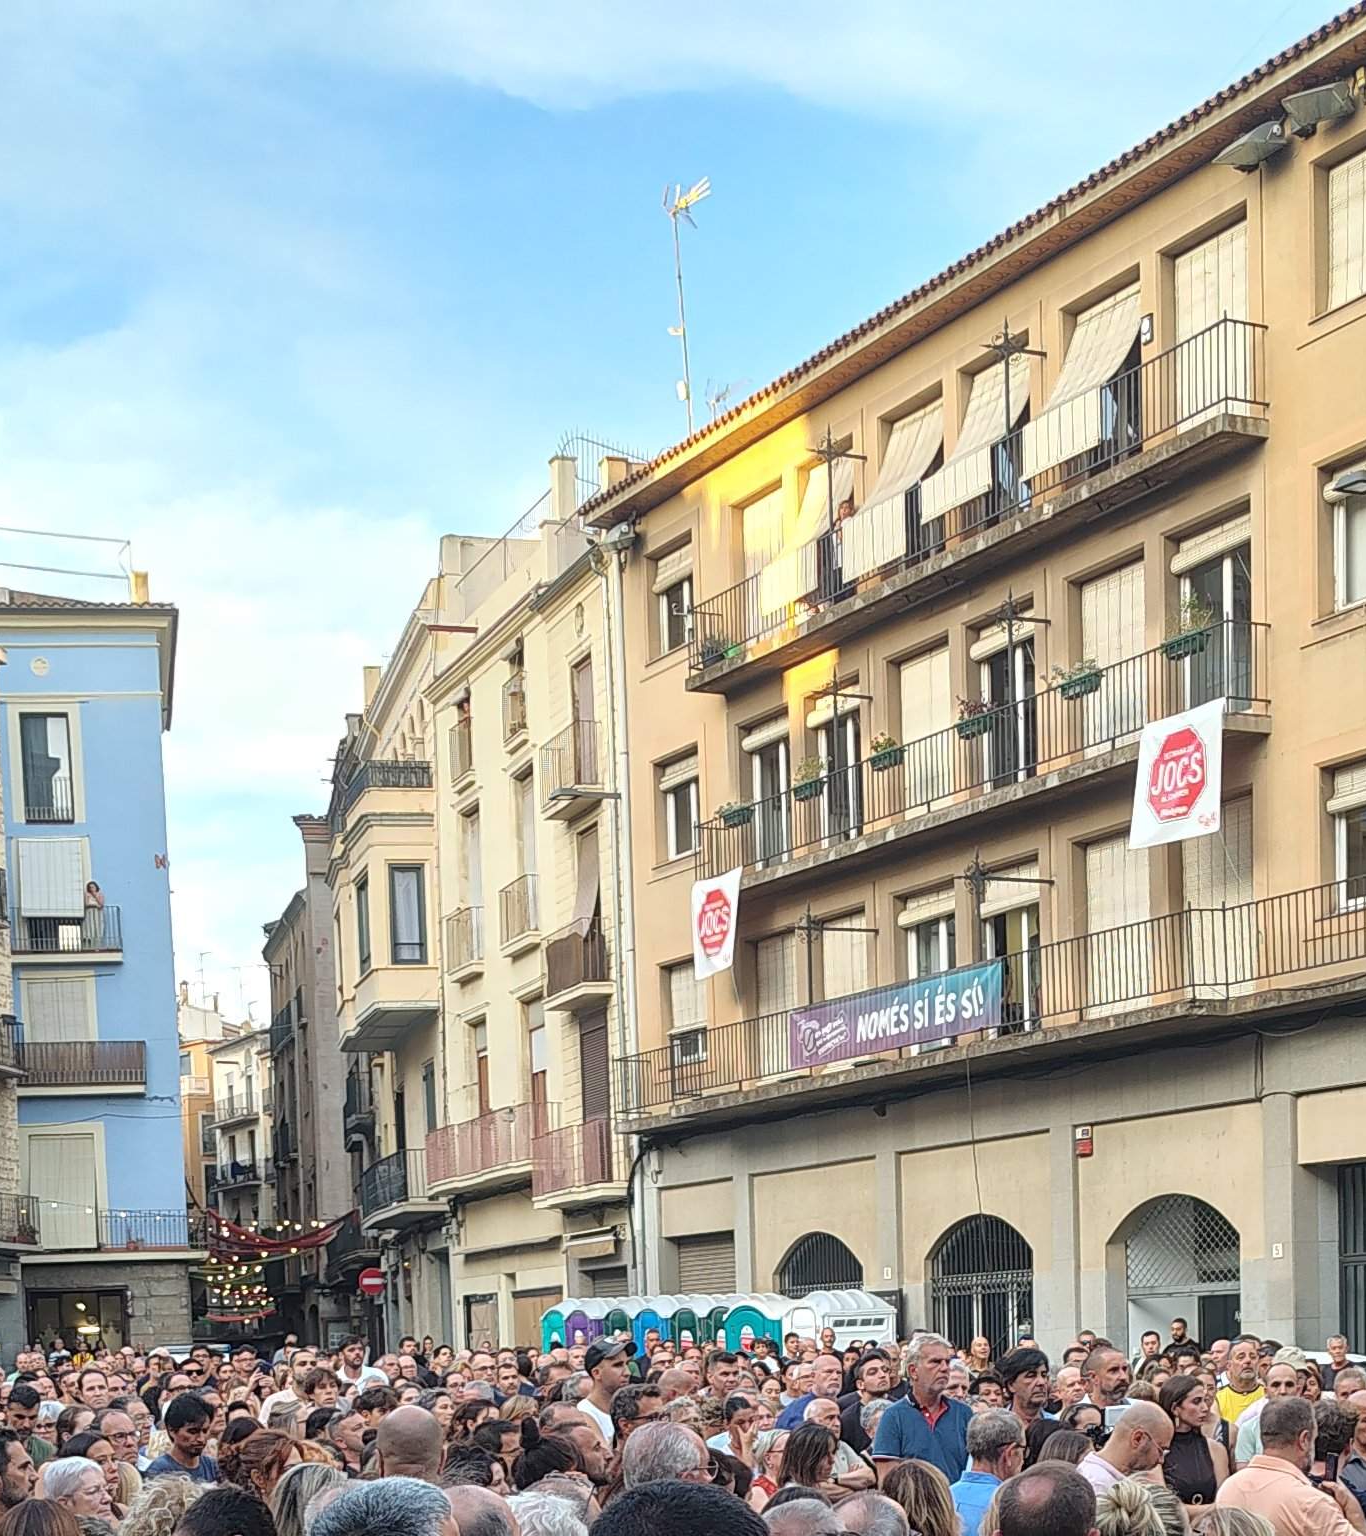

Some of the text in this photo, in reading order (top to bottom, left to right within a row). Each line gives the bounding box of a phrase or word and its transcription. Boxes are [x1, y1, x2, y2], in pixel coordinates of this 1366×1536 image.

[1150, 752, 1203, 796] JOCS
[856, 996, 910, 1043] NOMÉS
[913, 988, 929, 1030] SÍ
[934, 984, 956, 1026] ÉS
[961, 976, 984, 1019] SÍ!
